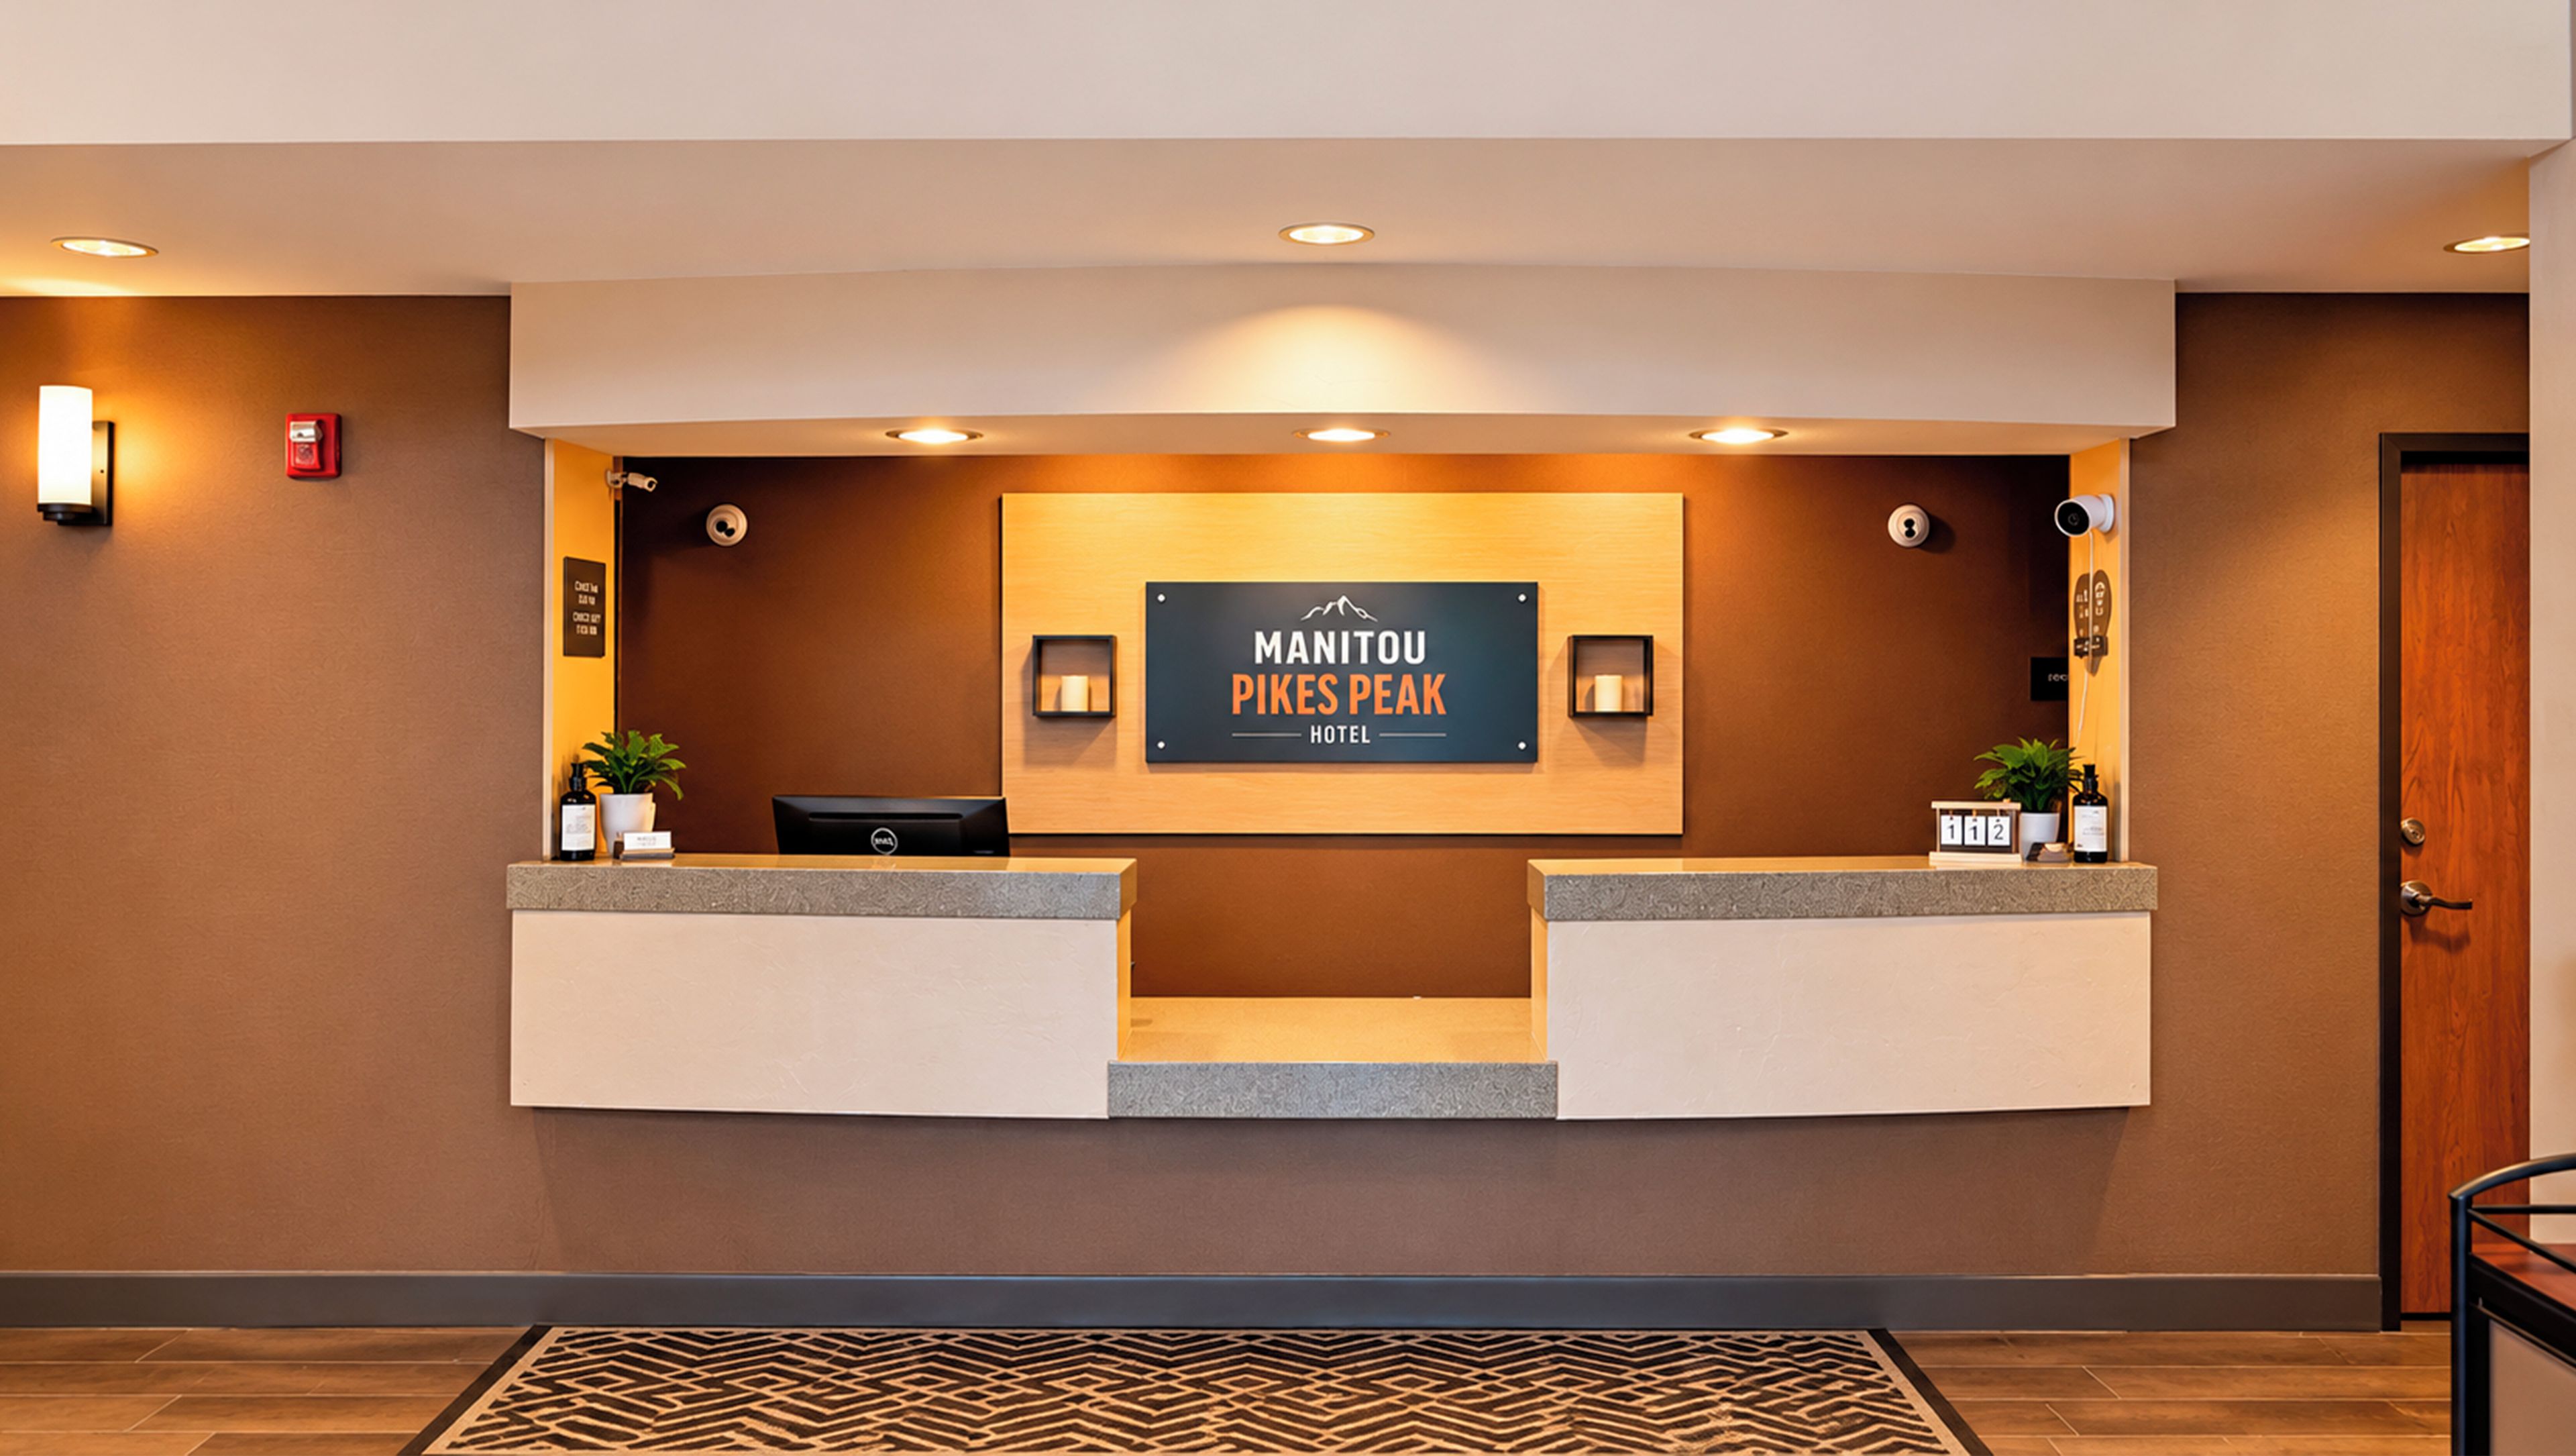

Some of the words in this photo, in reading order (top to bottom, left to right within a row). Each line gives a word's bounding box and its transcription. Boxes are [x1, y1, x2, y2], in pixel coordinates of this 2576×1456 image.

[1254, 631, 1426, 665] MANITOU
[1232, 673, 1338, 715] PIKES
[1349, 673, 1446, 715] PEAK
[1310, 725, 1371, 744] HOTEL
